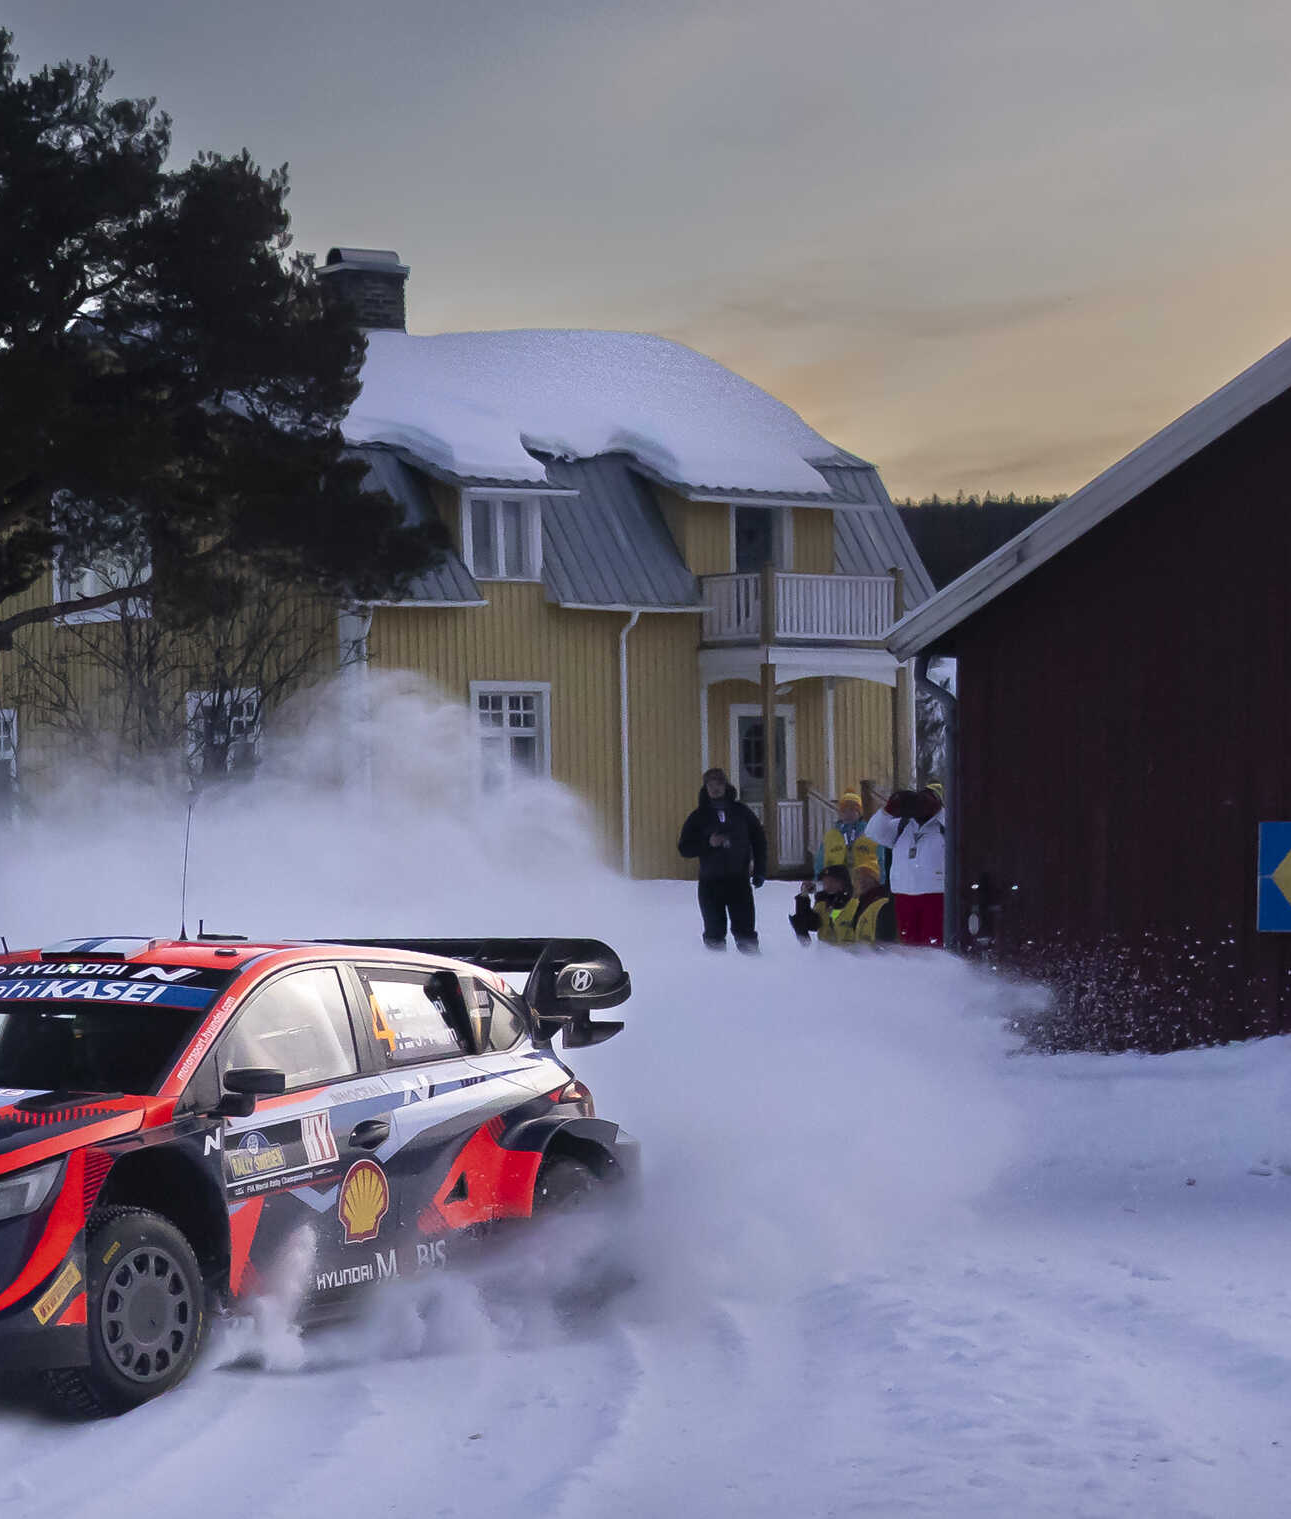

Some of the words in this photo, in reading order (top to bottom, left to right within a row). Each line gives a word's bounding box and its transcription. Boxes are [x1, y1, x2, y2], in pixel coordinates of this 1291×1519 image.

[9, 964, 128, 976] HYUNDAI
[369, 994, 396, 1052] 4
[204, 1126, 221, 1156] N
[316, 1263, 374, 1291] HYUNDAI
